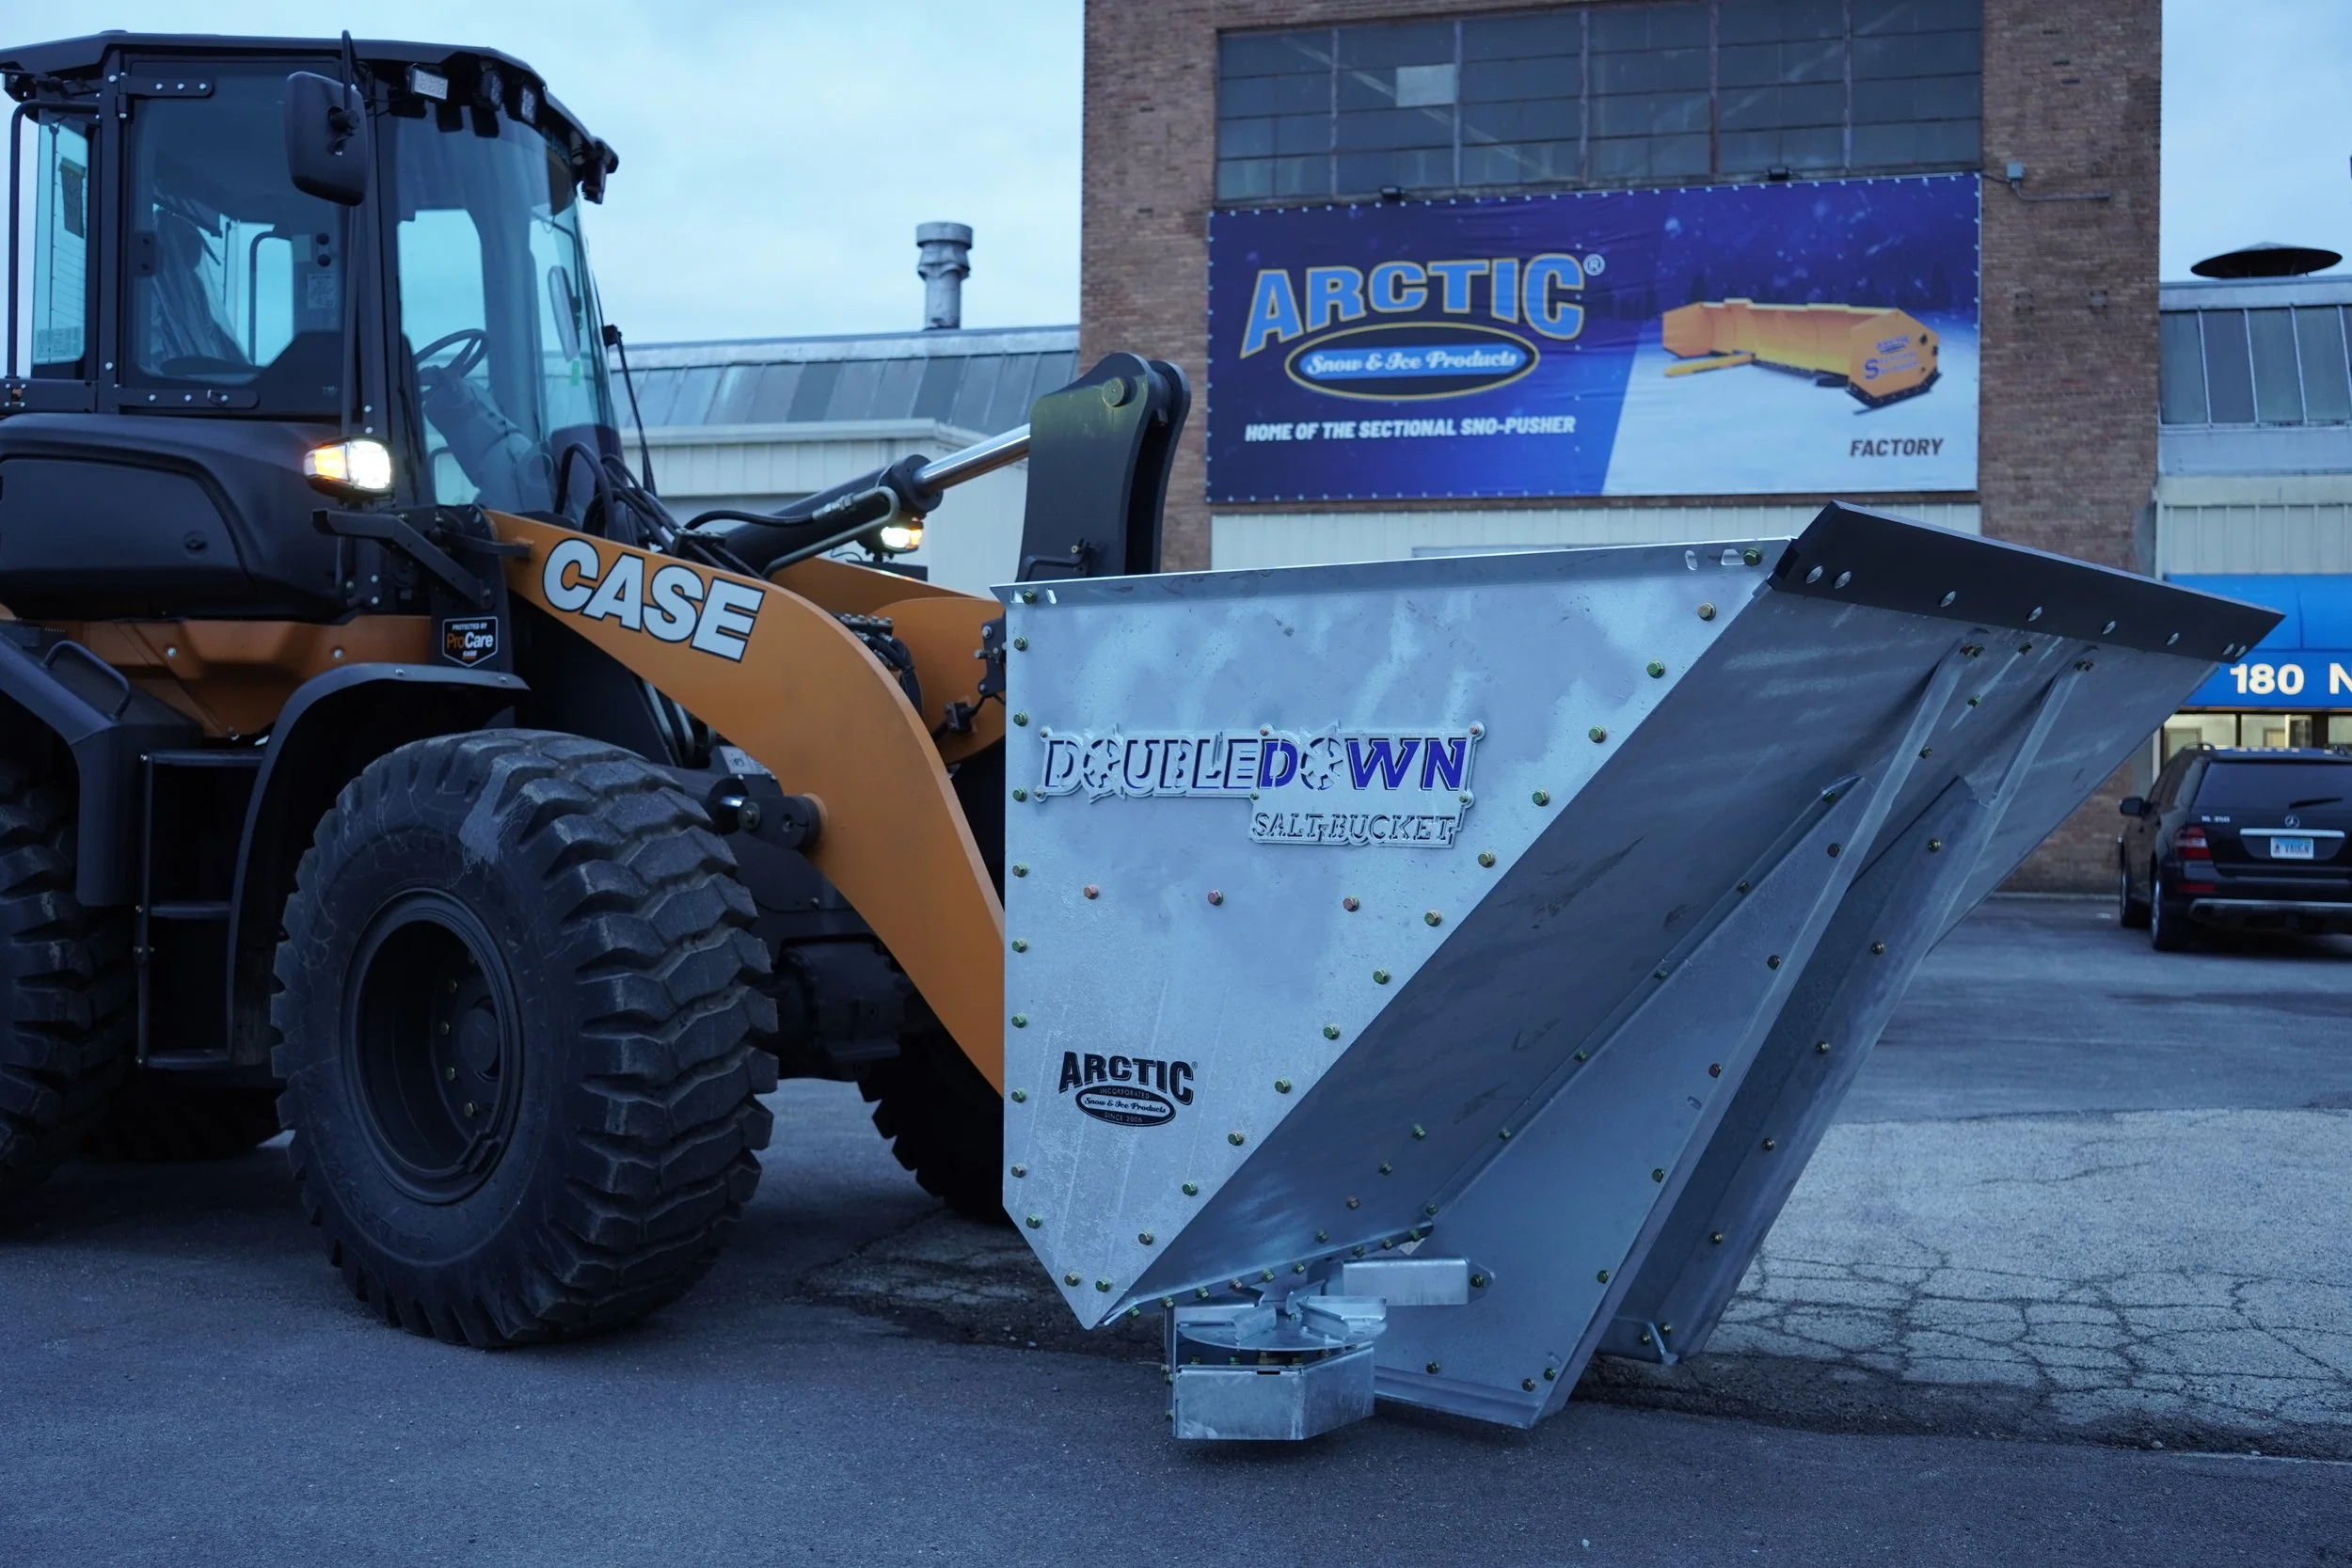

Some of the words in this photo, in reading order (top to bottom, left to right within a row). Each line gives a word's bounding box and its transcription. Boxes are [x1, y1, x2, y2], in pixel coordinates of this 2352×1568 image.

[1307, 354, 1362, 374] Snow
[1365, 353, 1382, 371] &
[1385, 352, 1422, 370] Ice
[1425, 349, 1517, 369] Products
[1245, 423, 1295, 442] HOME
[1295, 422, 1319, 440] OF
[1321, 421, 1358, 439] THE
[1358, 419, 1456, 438] SECTIONAL
[1460, 415, 1577, 436] SNO-PUSHER
[1850, 438, 1944, 457] FACTORY
[541, 537, 767, 663] CASE
[446, 631, 494, 649] ProCare
[2230, 662, 2305, 695] 180
[1058, 1051, 1194, 1106] ARCTIC
[1100, 1087, 1151, 1099] INCORPORATED
[1085, 1097, 1105, 1106] Snow
[1106, 1099, 1114, 1107] &
[1115, 1101, 1129, 1109] Ice
[1130, 1102, 1167, 1114] Products
[1104, 1112, 1123, 1121] SINCE
